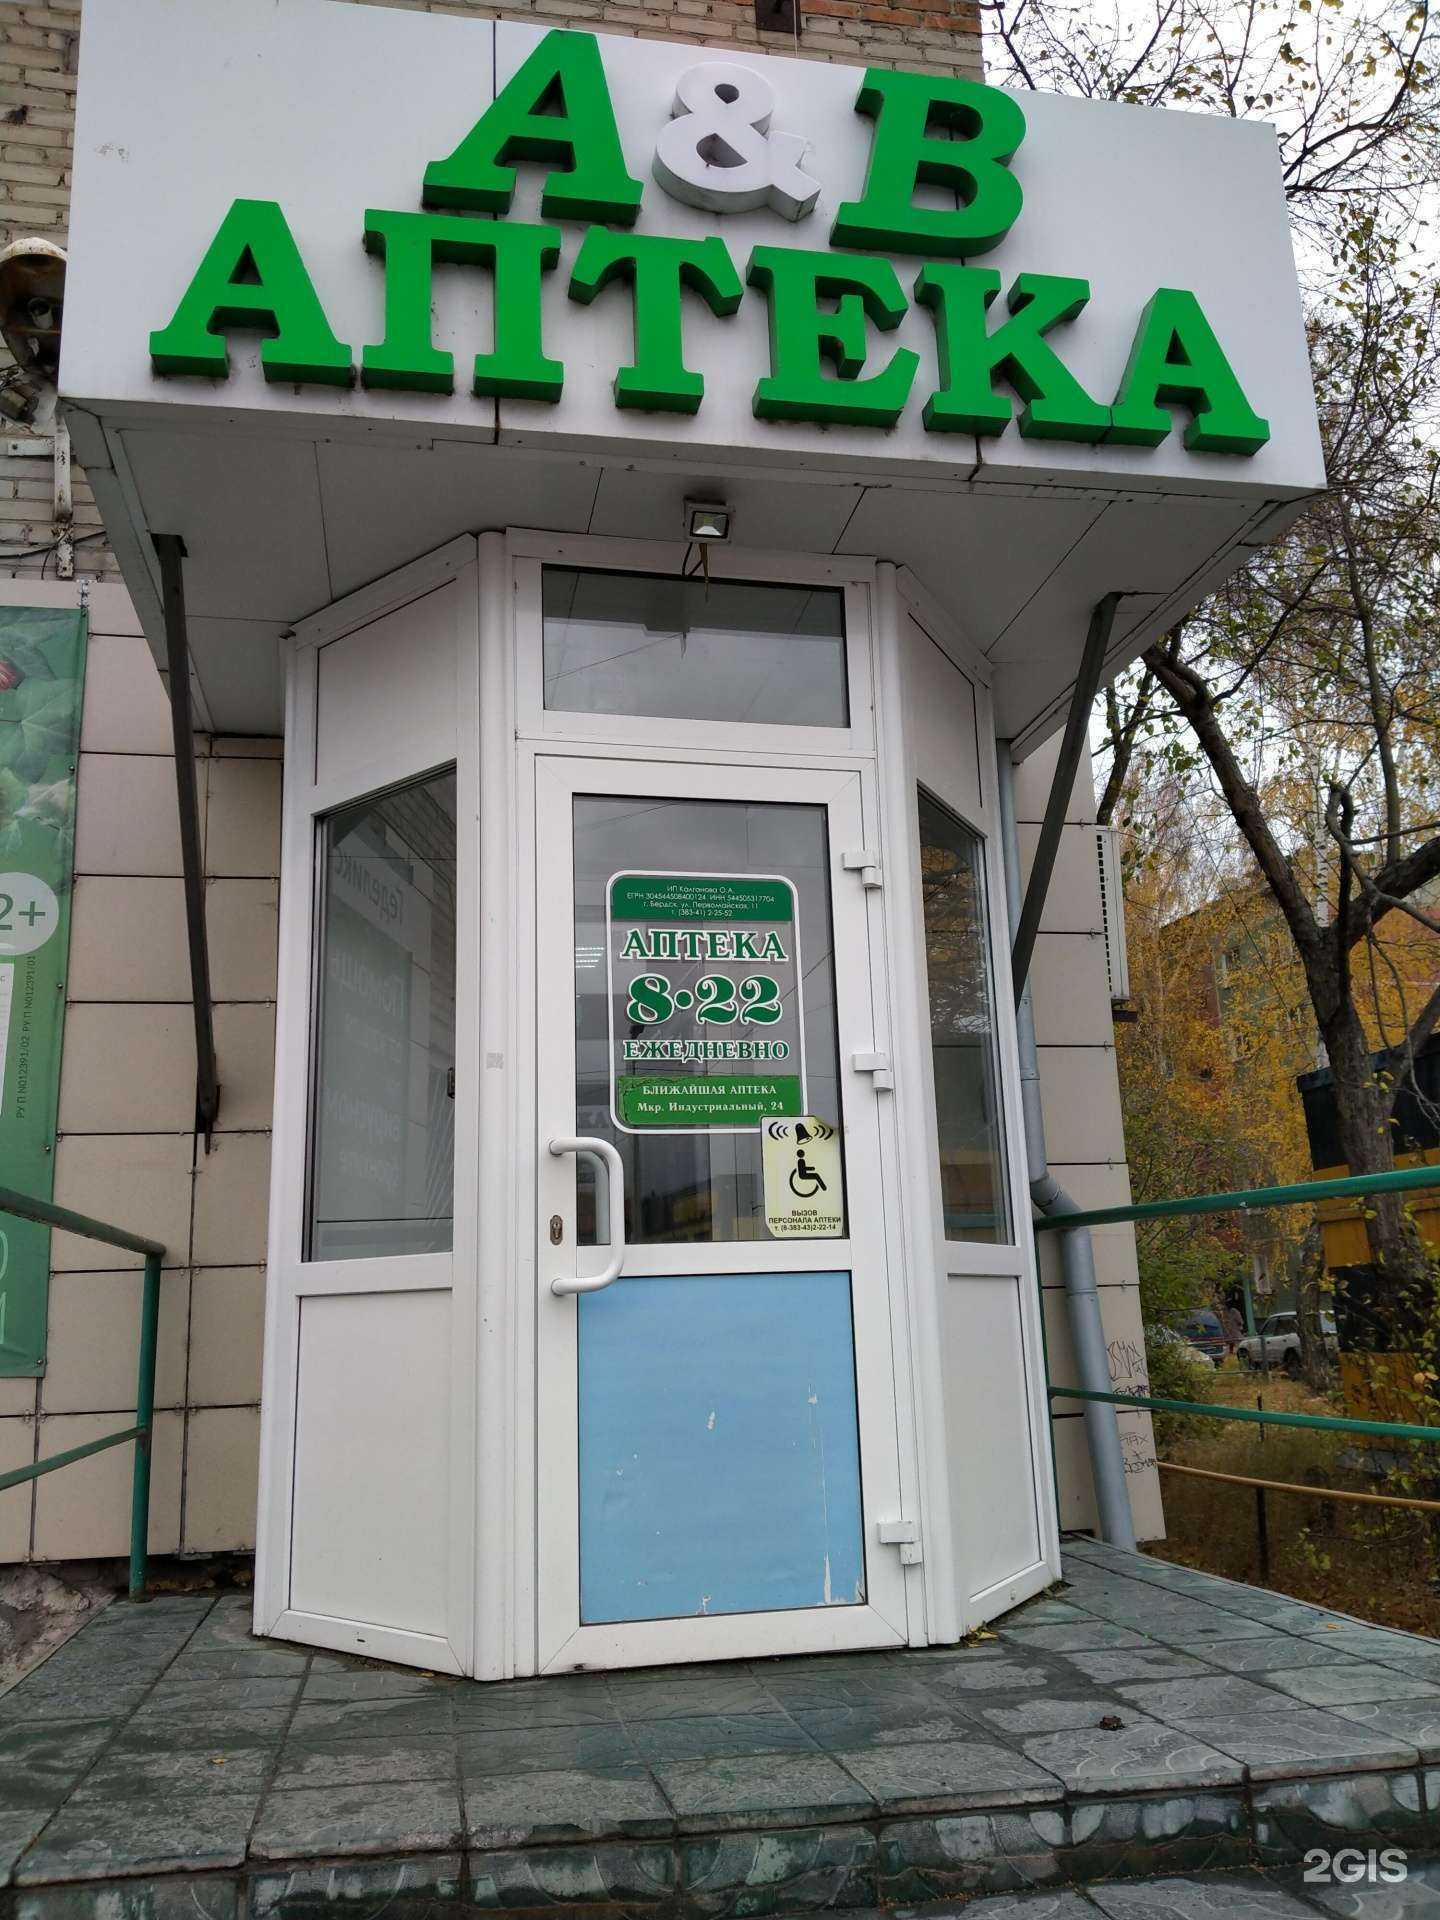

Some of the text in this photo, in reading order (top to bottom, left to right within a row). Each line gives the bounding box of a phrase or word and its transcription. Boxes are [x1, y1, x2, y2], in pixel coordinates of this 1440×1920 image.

[149, 198, 1270, 456] АПТЕКА
[666, 885, 678, 893] ИП
[620, 928, 789, 962] АПТЕКА
[623, 1040, 790, 1063] ЕЖЕДНЕВНО
[642, 1085, 777, 1096] БЛИЖАЙШАЯ АПТЕКА
[637, 1101, 784, 1114] Мкр. Индустриальный, 24
[791, 1209, 818, 1217] ВЫЗОВ
